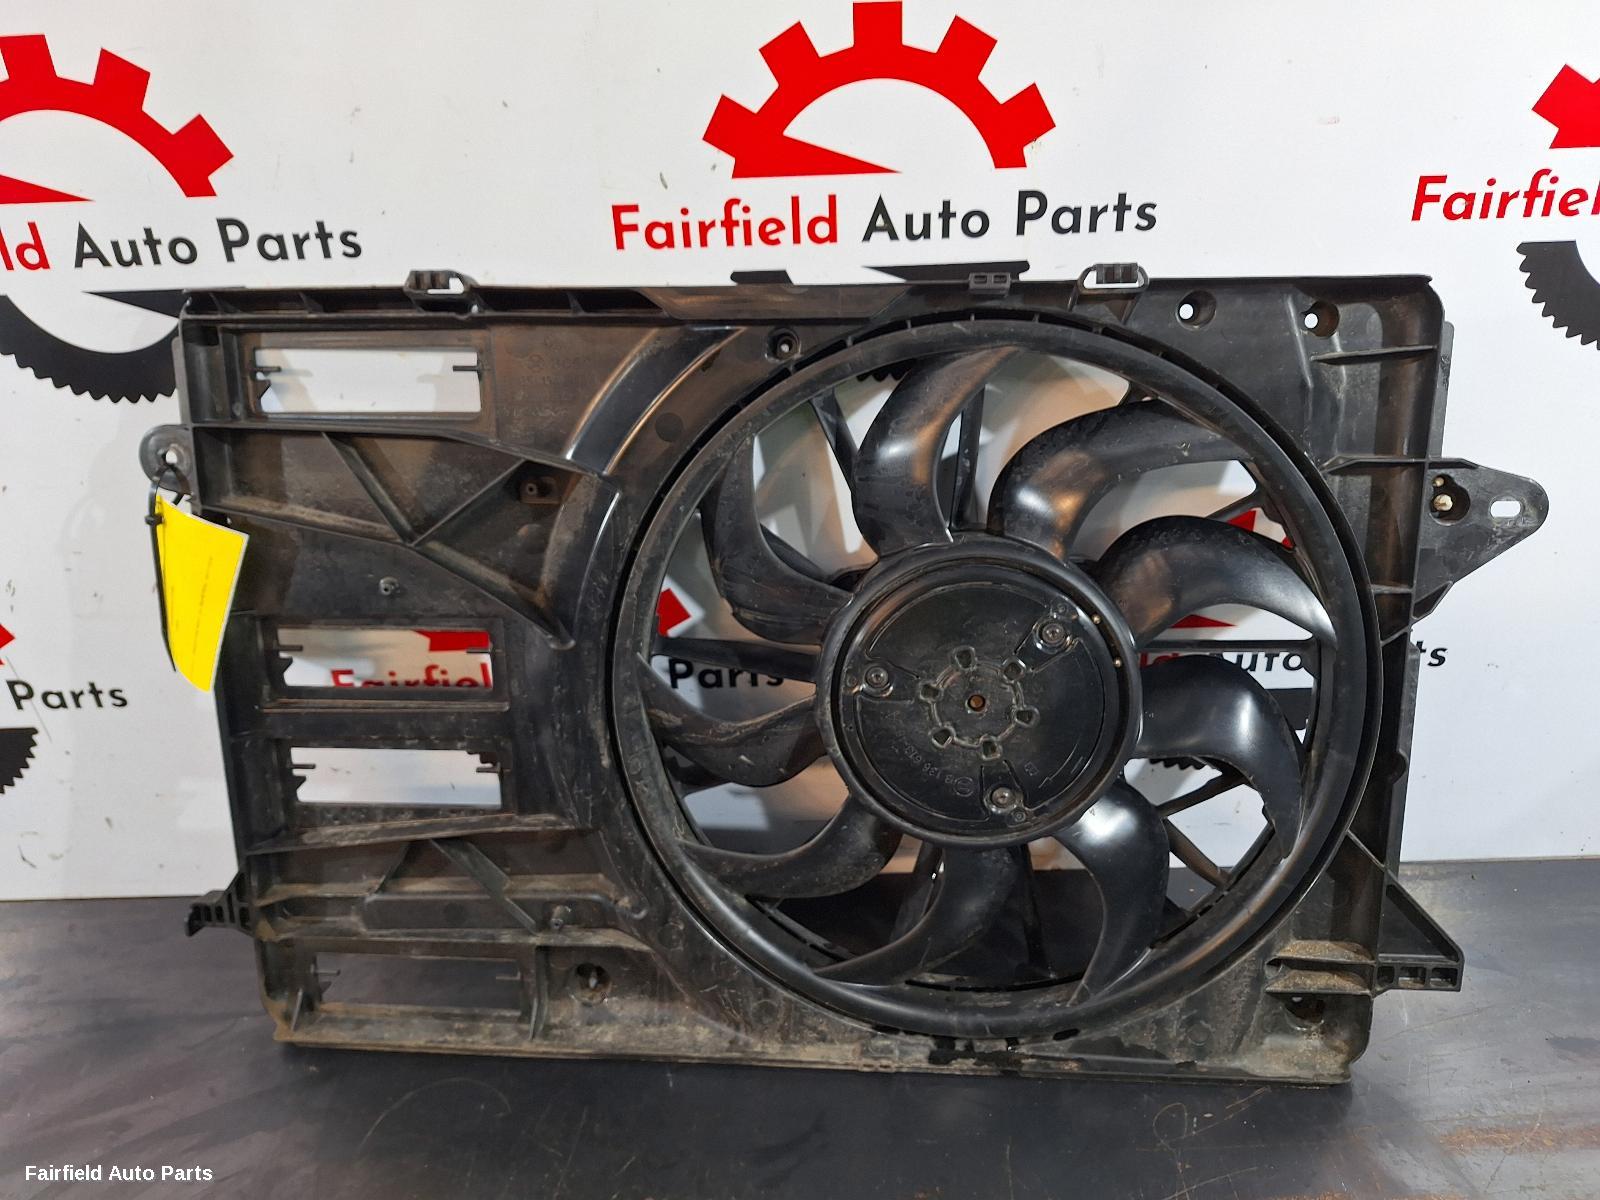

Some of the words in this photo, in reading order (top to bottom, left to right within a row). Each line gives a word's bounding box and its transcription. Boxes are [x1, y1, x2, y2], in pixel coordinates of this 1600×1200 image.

[74, 221, 198, 268] Auto
[216, 217, 362, 262] Parts
[611, 194, 838, 250] Fairfield
[862, 195, 990, 242] Auto
[1016, 190, 1157, 236] Parts
[6, 679, 128, 710] Parts
